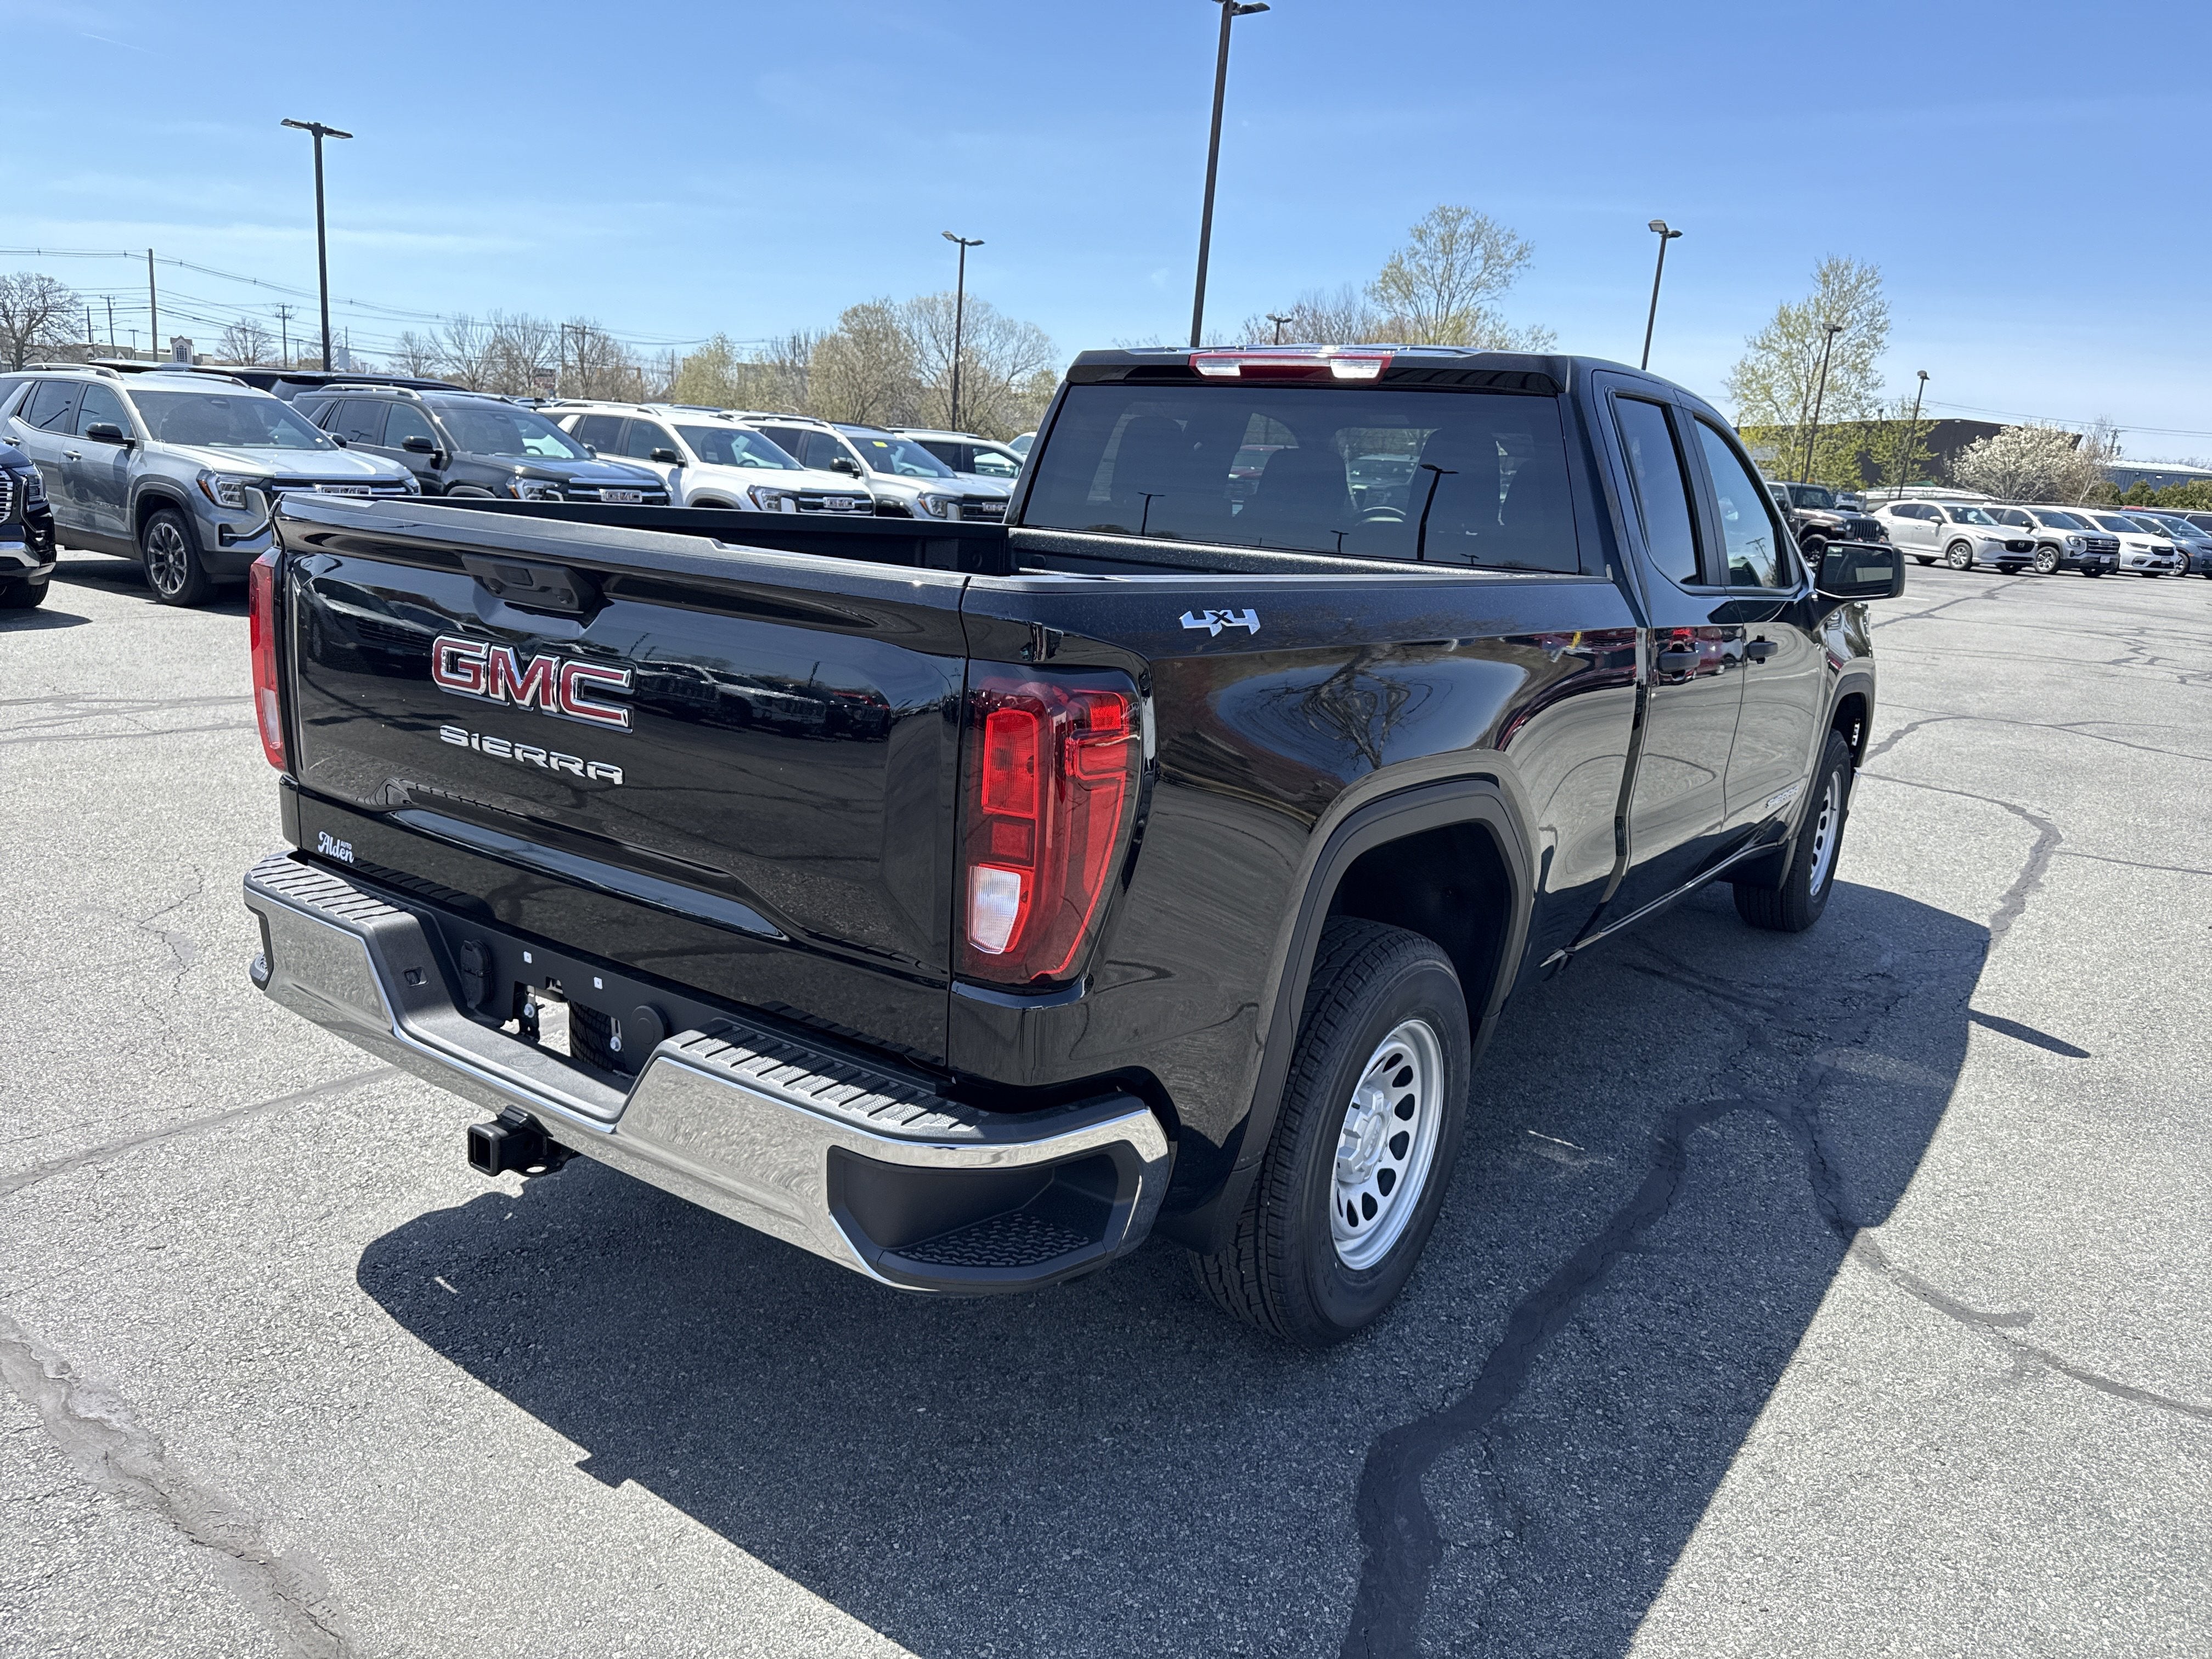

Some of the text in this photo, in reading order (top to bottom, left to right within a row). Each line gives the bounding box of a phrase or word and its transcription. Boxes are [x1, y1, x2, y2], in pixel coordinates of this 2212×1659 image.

[432, 634, 631, 727] GMC
[439, 724, 623, 785] SIERRA
[318, 831, 354, 864] Alden
[340, 840, 352, 850] AUTO
